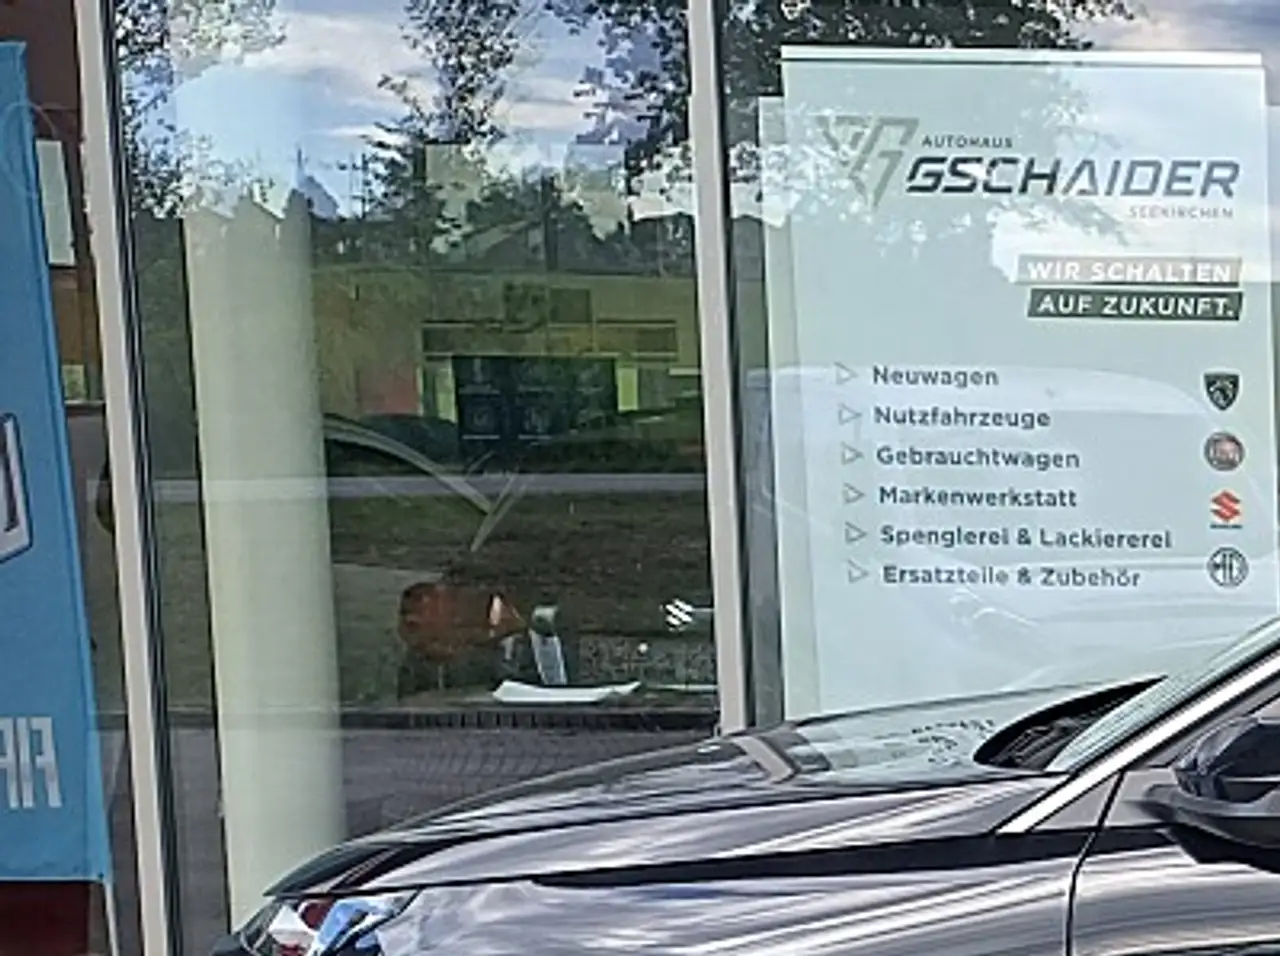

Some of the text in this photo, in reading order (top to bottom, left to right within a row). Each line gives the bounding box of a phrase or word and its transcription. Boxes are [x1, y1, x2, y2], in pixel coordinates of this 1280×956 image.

[921, 135, 1013, 149] AUTOHAUS
[906, 157, 1240, 198] GSCHAIDER
[1129, 206, 1234, 219] SEEKIRCHEN
[1027, 261, 1231, 284] WIR SCHALTEN
[1037, 295, 1235, 317] AUF ZUKUNFT.
[873, 367, 999, 388] Neuwagen
[874, 407, 1051, 429] Nutzfahrzeuge
[877, 448, 1080, 470] Gebrauchtwagen
[879, 487, 1077, 508] Markenwerkstatt
[880, 526, 1171, 549] Spenglerei & Lackiererei
[883, 566, 1140, 588] Ersatzteile & Zubehör
